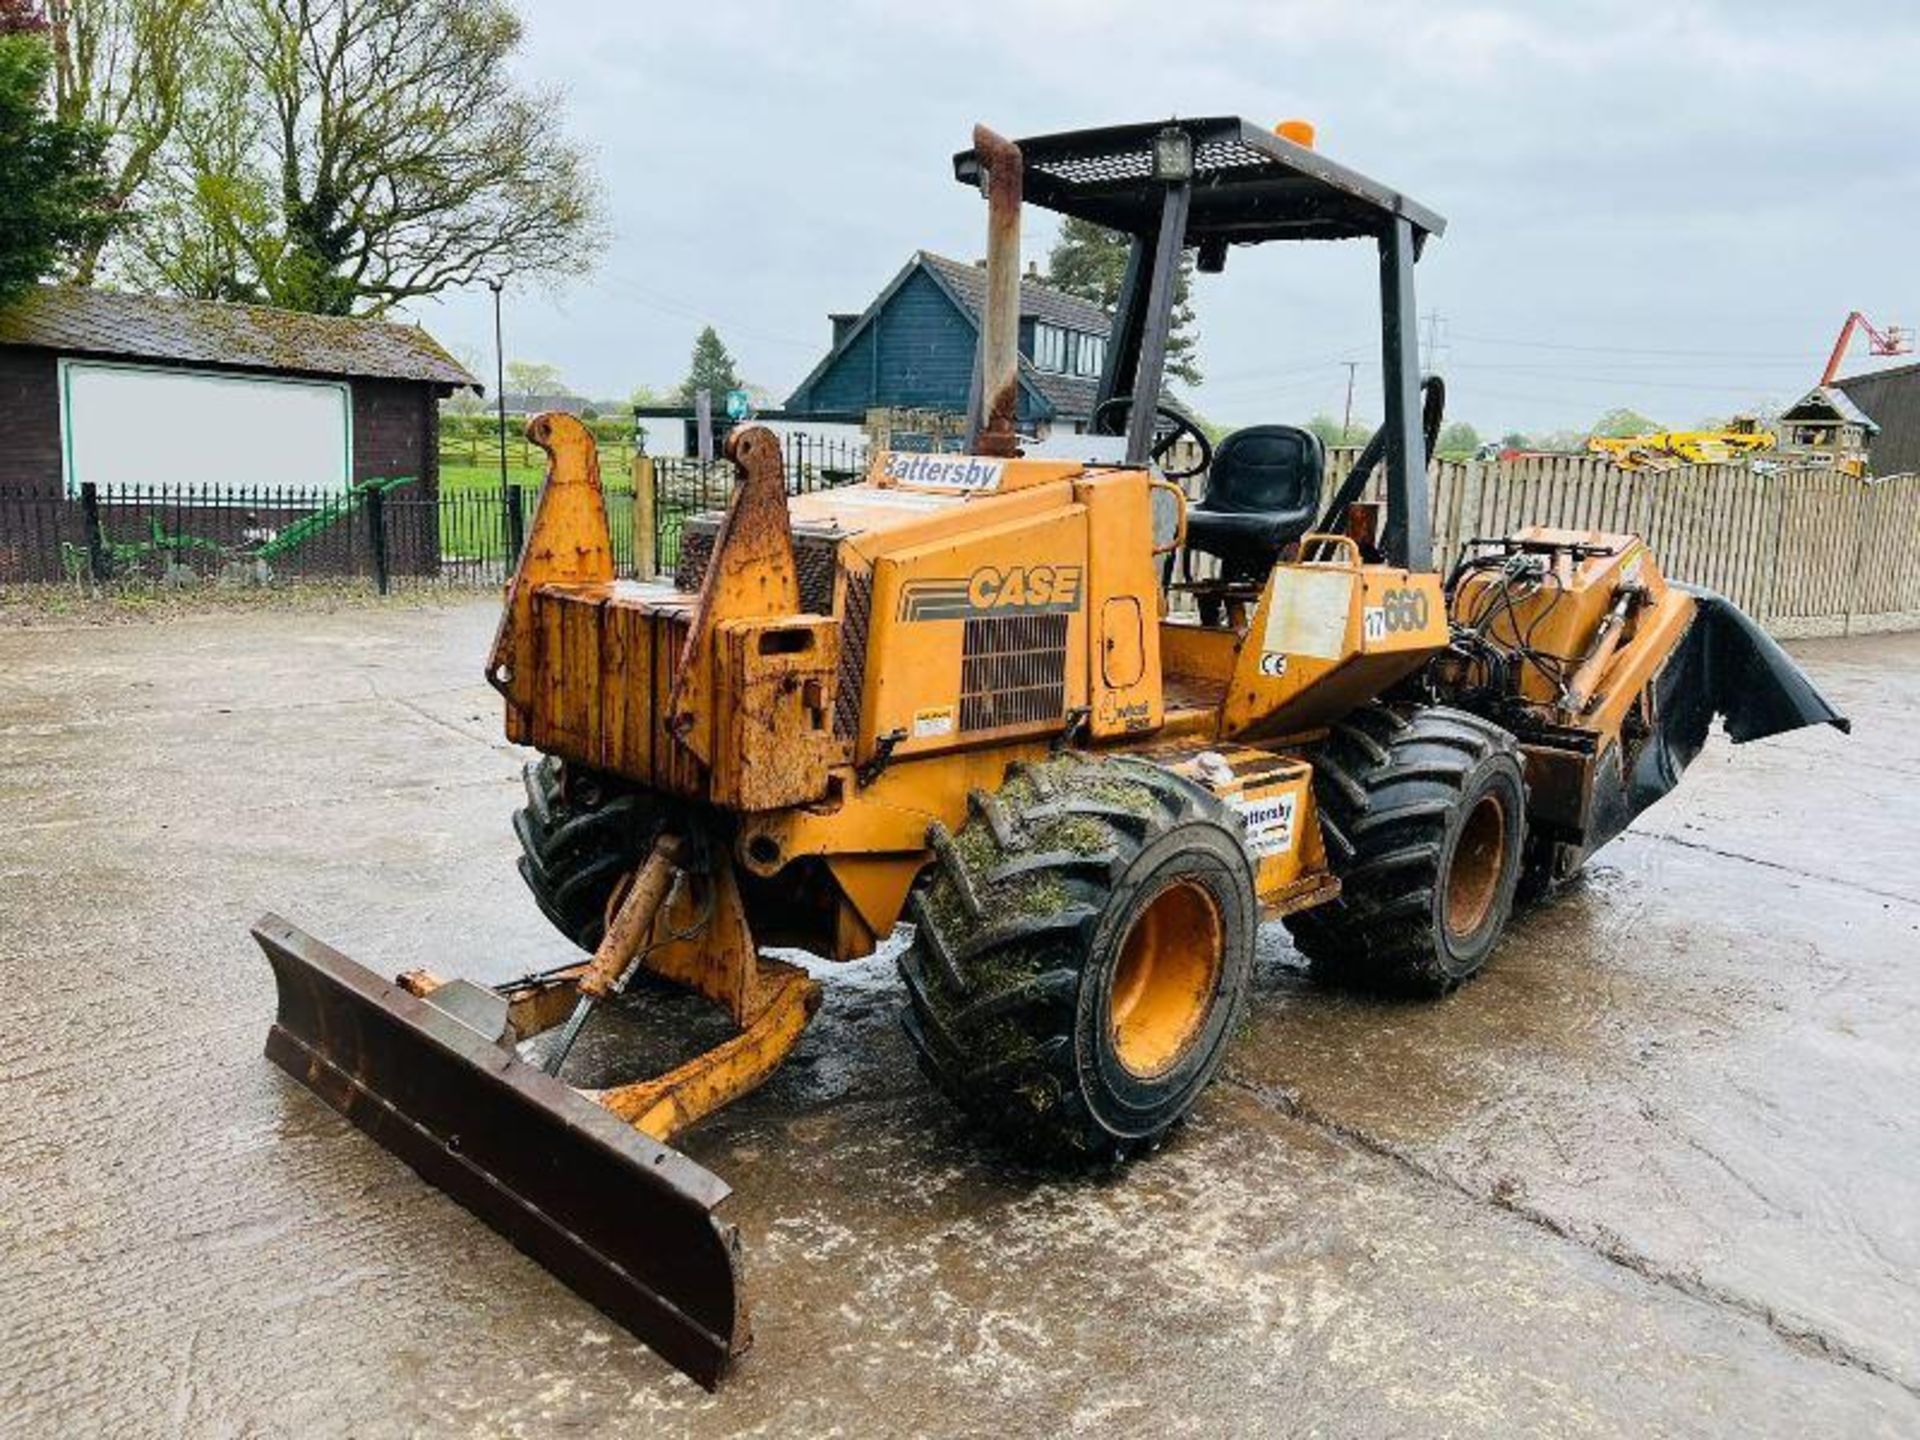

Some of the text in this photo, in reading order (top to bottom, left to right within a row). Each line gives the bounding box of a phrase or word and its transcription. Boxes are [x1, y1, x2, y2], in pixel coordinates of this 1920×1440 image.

[969, 565, 1081, 609] CASE
[1365, 611, 1383, 636] 17
[1241, 803, 1292, 829] attersby
